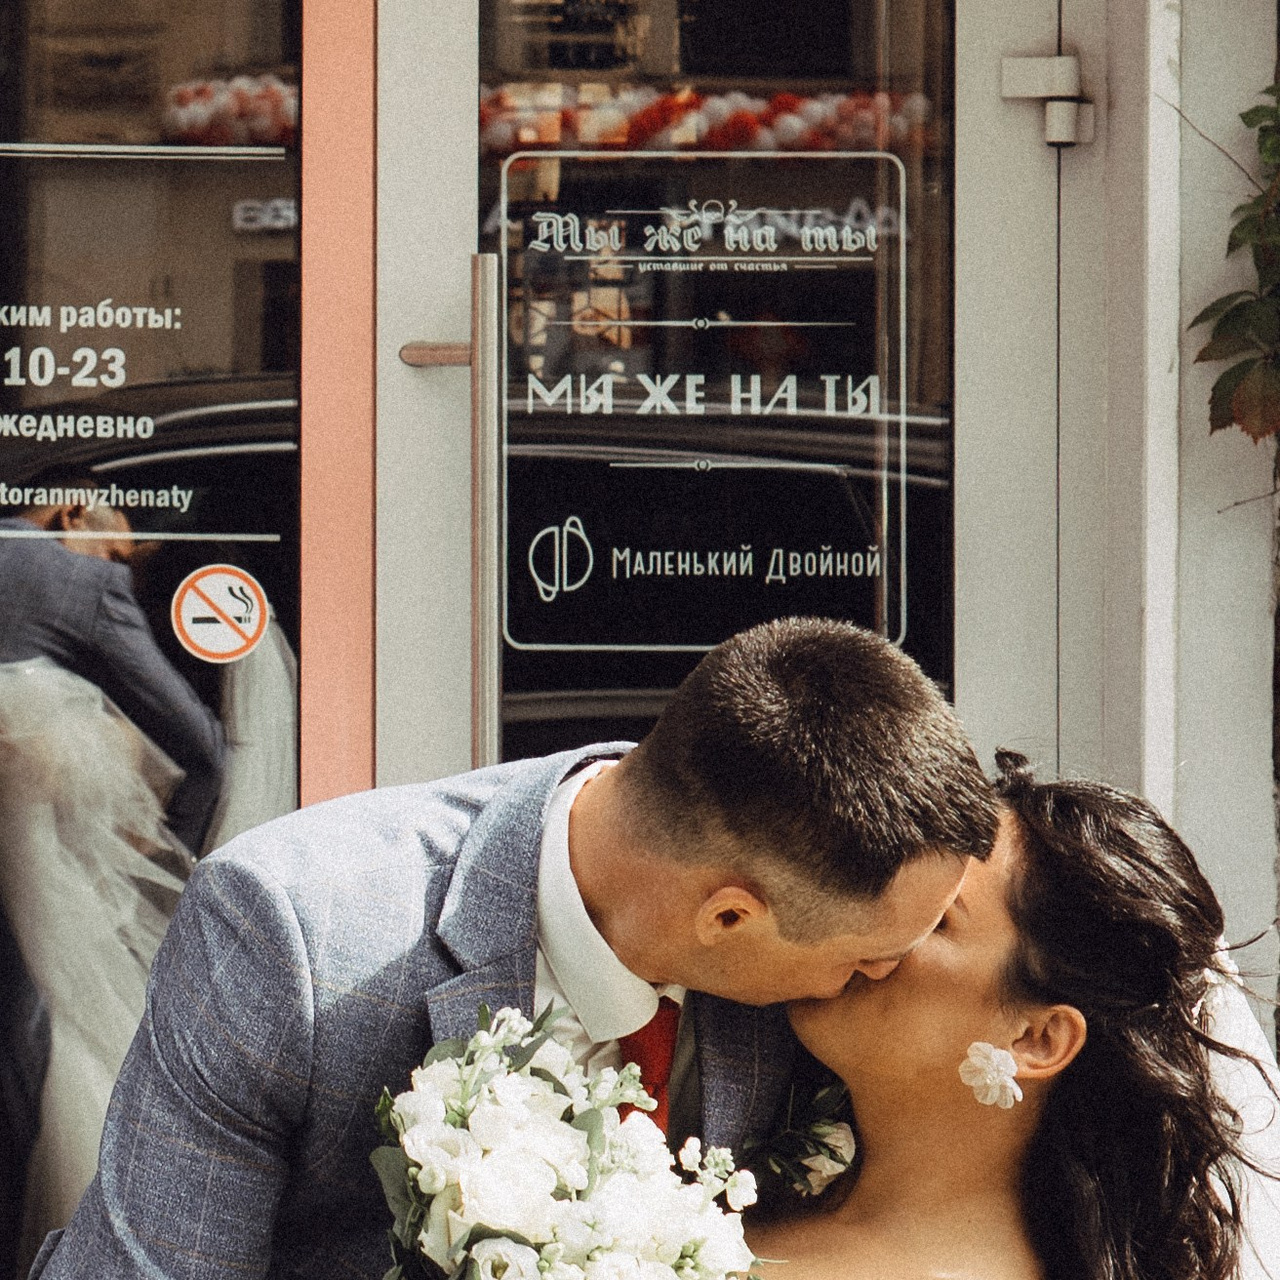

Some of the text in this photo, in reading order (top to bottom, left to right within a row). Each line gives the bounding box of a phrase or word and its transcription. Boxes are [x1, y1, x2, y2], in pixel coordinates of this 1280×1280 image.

[528, 211, 878, 253] Мы же на ты
[638, 262, 788, 273] уставшие от счастья
[60, 298, 182, 333] работы:
[3, 346, 126, 388] 10-23
[527, 374, 883, 417] МЫ ЖЕ НА ТЫ
